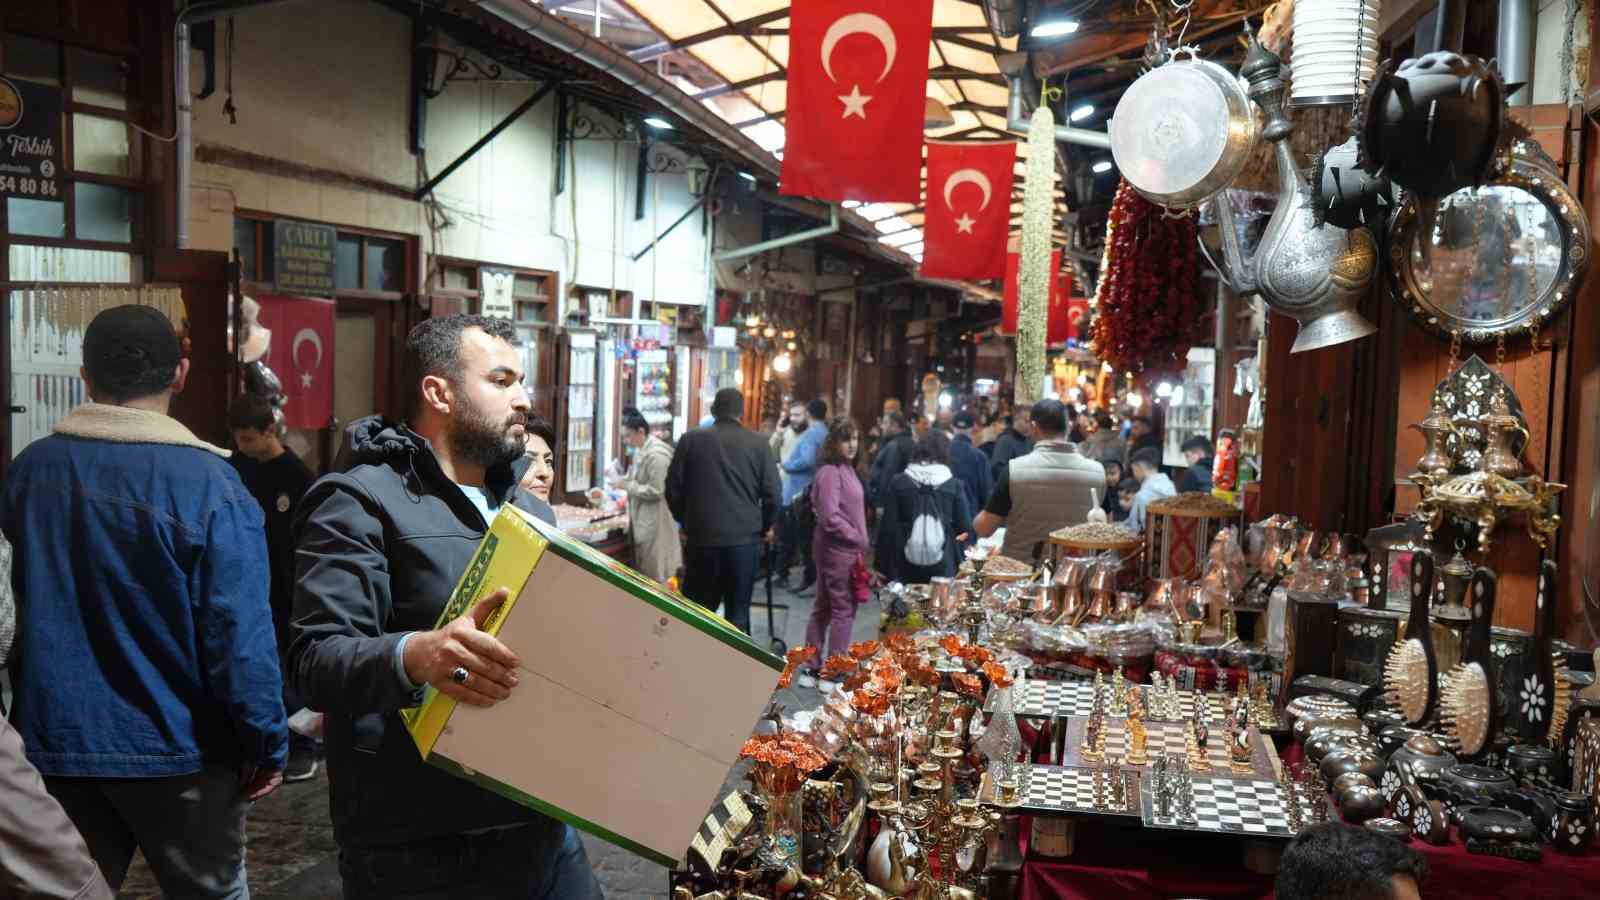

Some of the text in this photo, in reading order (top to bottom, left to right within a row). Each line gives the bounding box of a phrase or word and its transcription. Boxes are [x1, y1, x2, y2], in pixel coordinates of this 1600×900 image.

[6, 134, 53, 157] Tesbih
[20, 177, 37, 194] 80
[40, 179, 57, 196] 86
